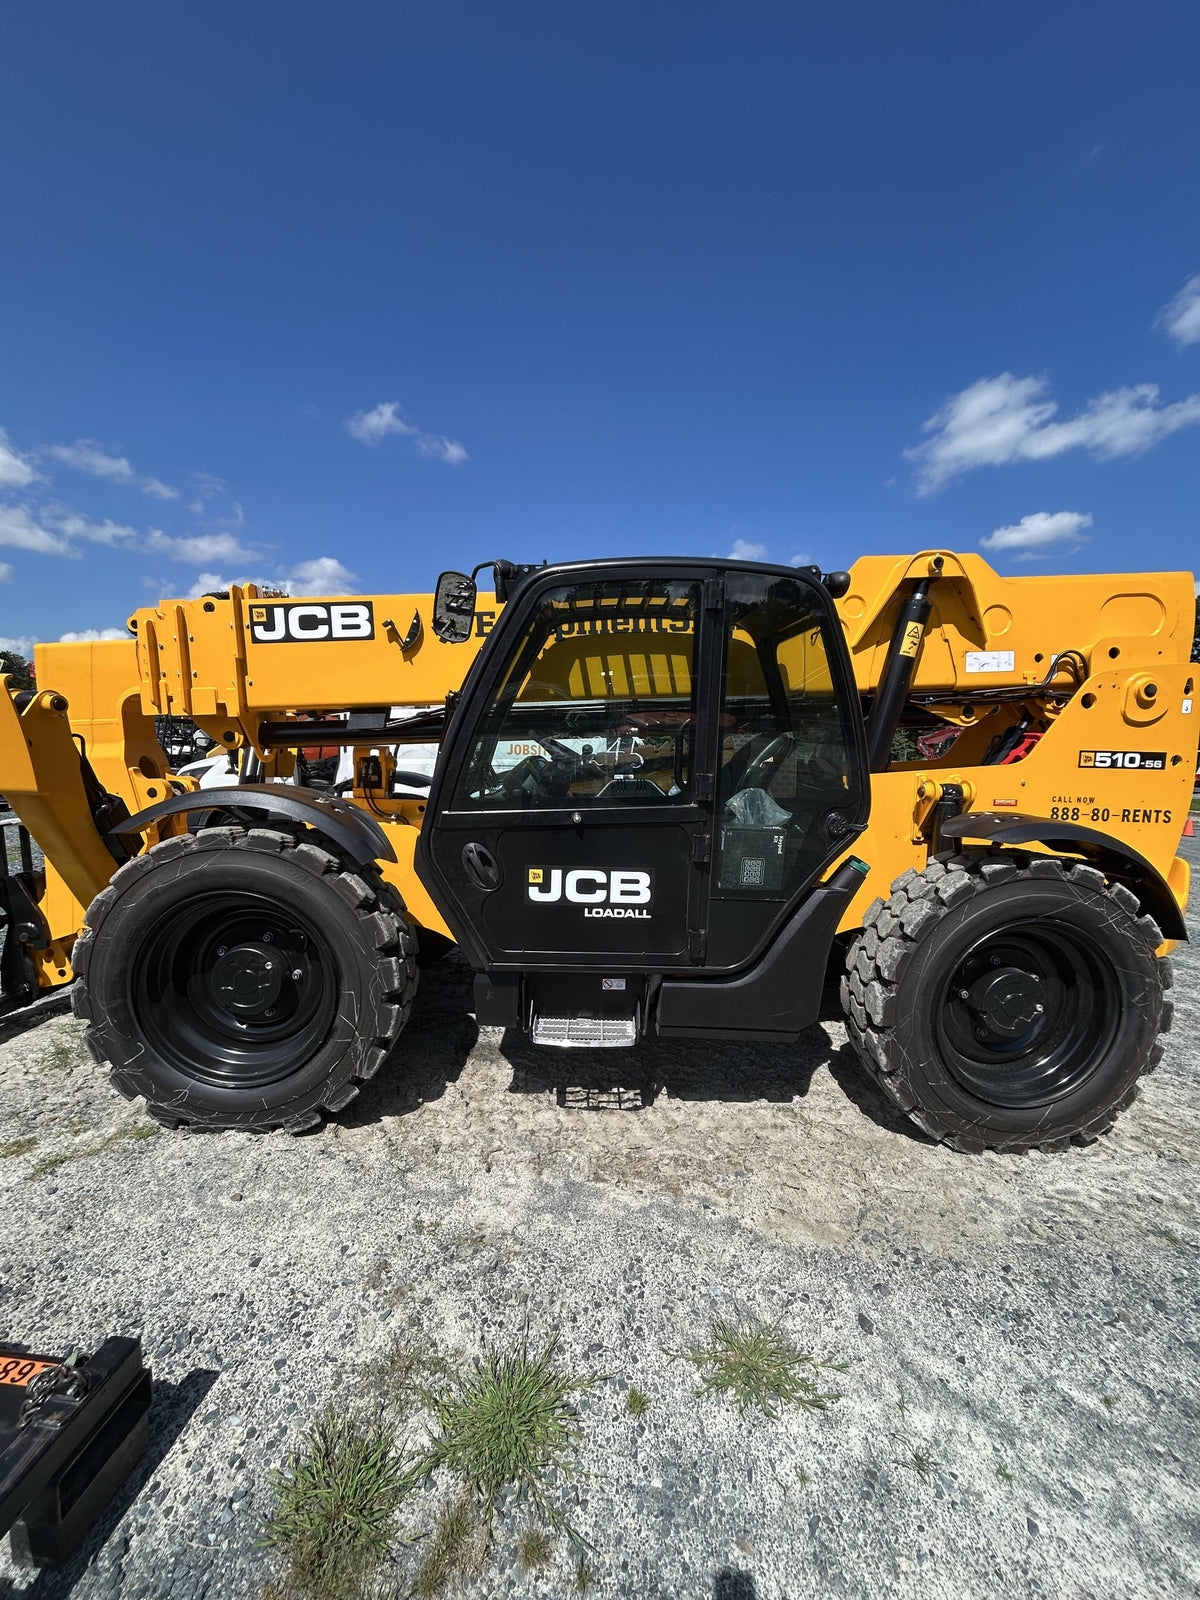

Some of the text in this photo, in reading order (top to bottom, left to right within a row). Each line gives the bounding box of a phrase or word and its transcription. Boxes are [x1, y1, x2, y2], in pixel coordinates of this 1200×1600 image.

[253, 605, 372, 641] JCB
[1094, 752, 1163, 768] 510-56
[1076, 796, 1096, 804] NOW
[528, 869, 652, 904] JCB
[584, 907, 652, 919] LOADALL
